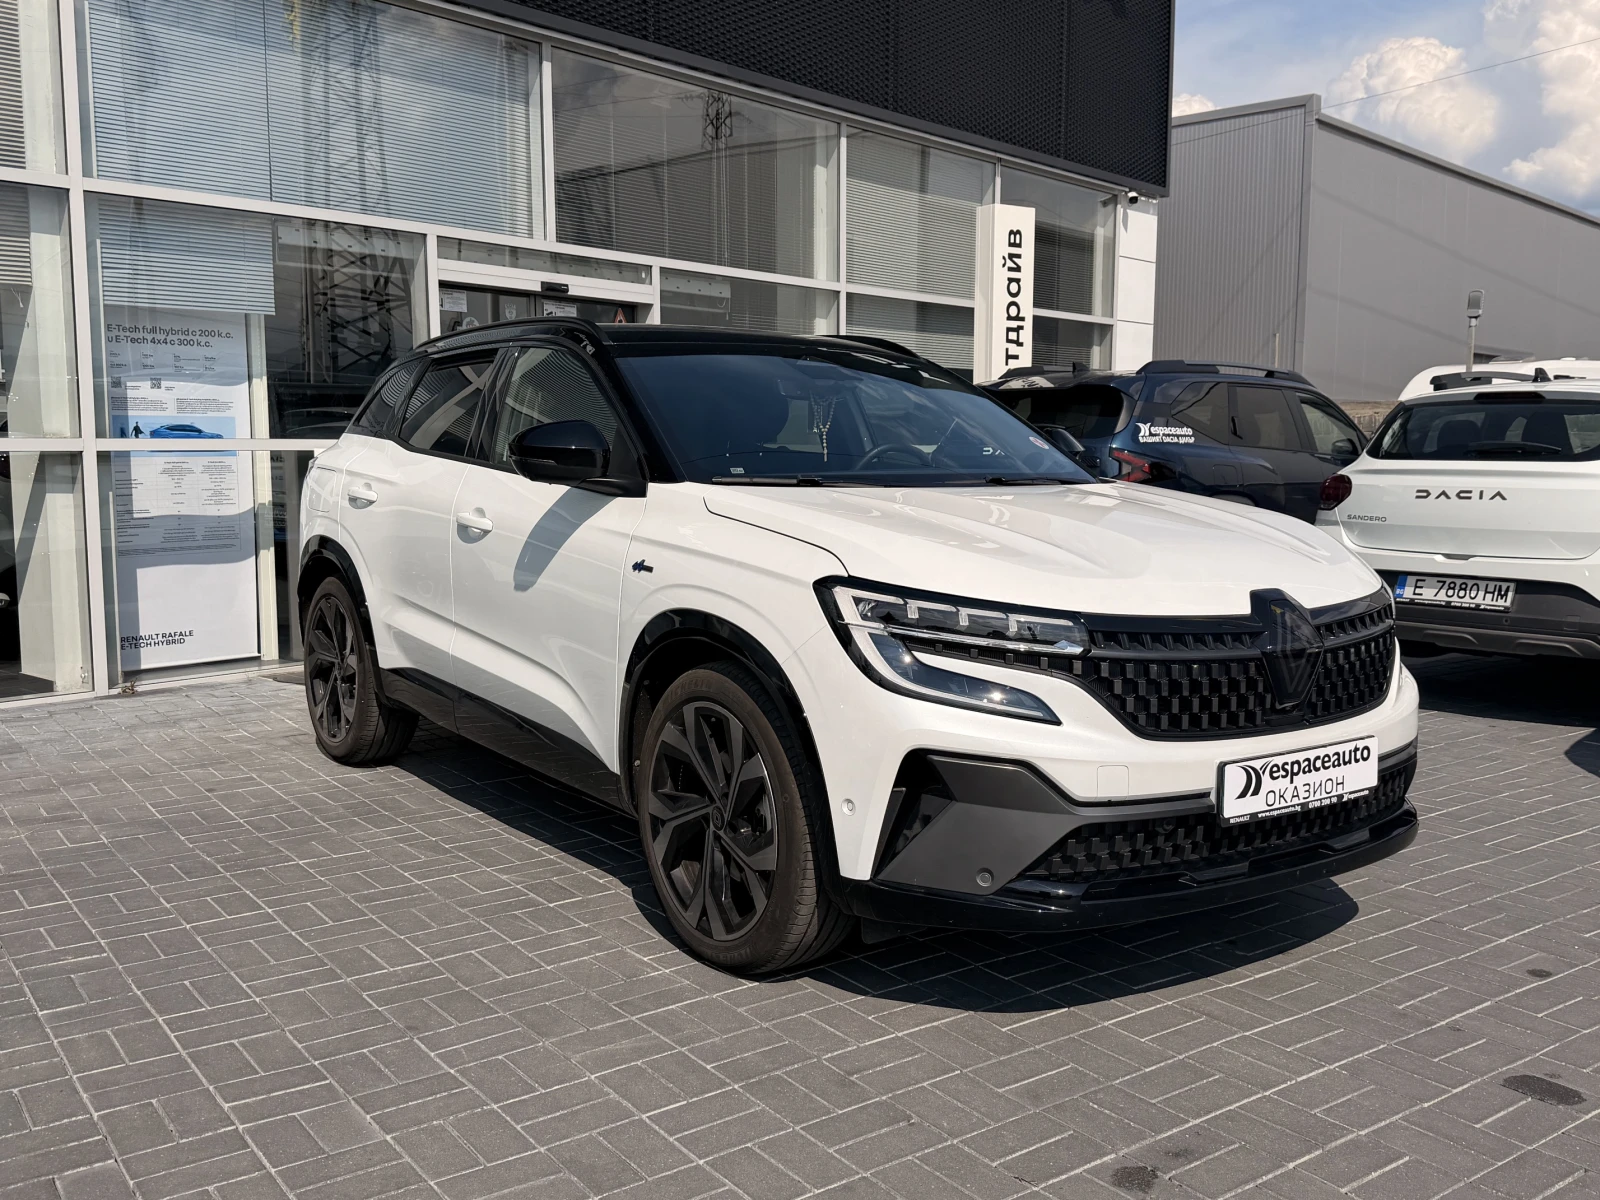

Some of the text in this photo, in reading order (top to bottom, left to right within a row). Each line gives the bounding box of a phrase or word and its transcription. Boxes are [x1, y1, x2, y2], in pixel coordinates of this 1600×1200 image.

[107, 324, 140, 334] E-Tech
[142, 326, 157, 334] full
[159, 326, 189, 337] hybrid
[198, 329, 216, 338] 200
[115, 335, 148, 344] E-Tech
[150, 336, 168, 346] 4x4
[177, 338, 194, 347] 300
[1150, 426, 1193, 436] espaceauto
[1415, 489, 1507, 501] DACIA
[1347, 514, 1387, 522] SANDERO
[1412, 579, 1426, 596] E
[1434, 580, 1480, 600] 7880
[1483, 584, 1510, 603] HM
[121, 630, 194, 643] RENAULT RAFALE
[121, 638, 185, 650] E-TECH HYBRID
[1269, 743, 1370, 784] espaceauto
[1266, 775, 1344, 807] ОКАЗИОН
[1230, 815, 1250, 824] RENAULT
[1258, 805, 1302, 818] www.espaceauto.bg
